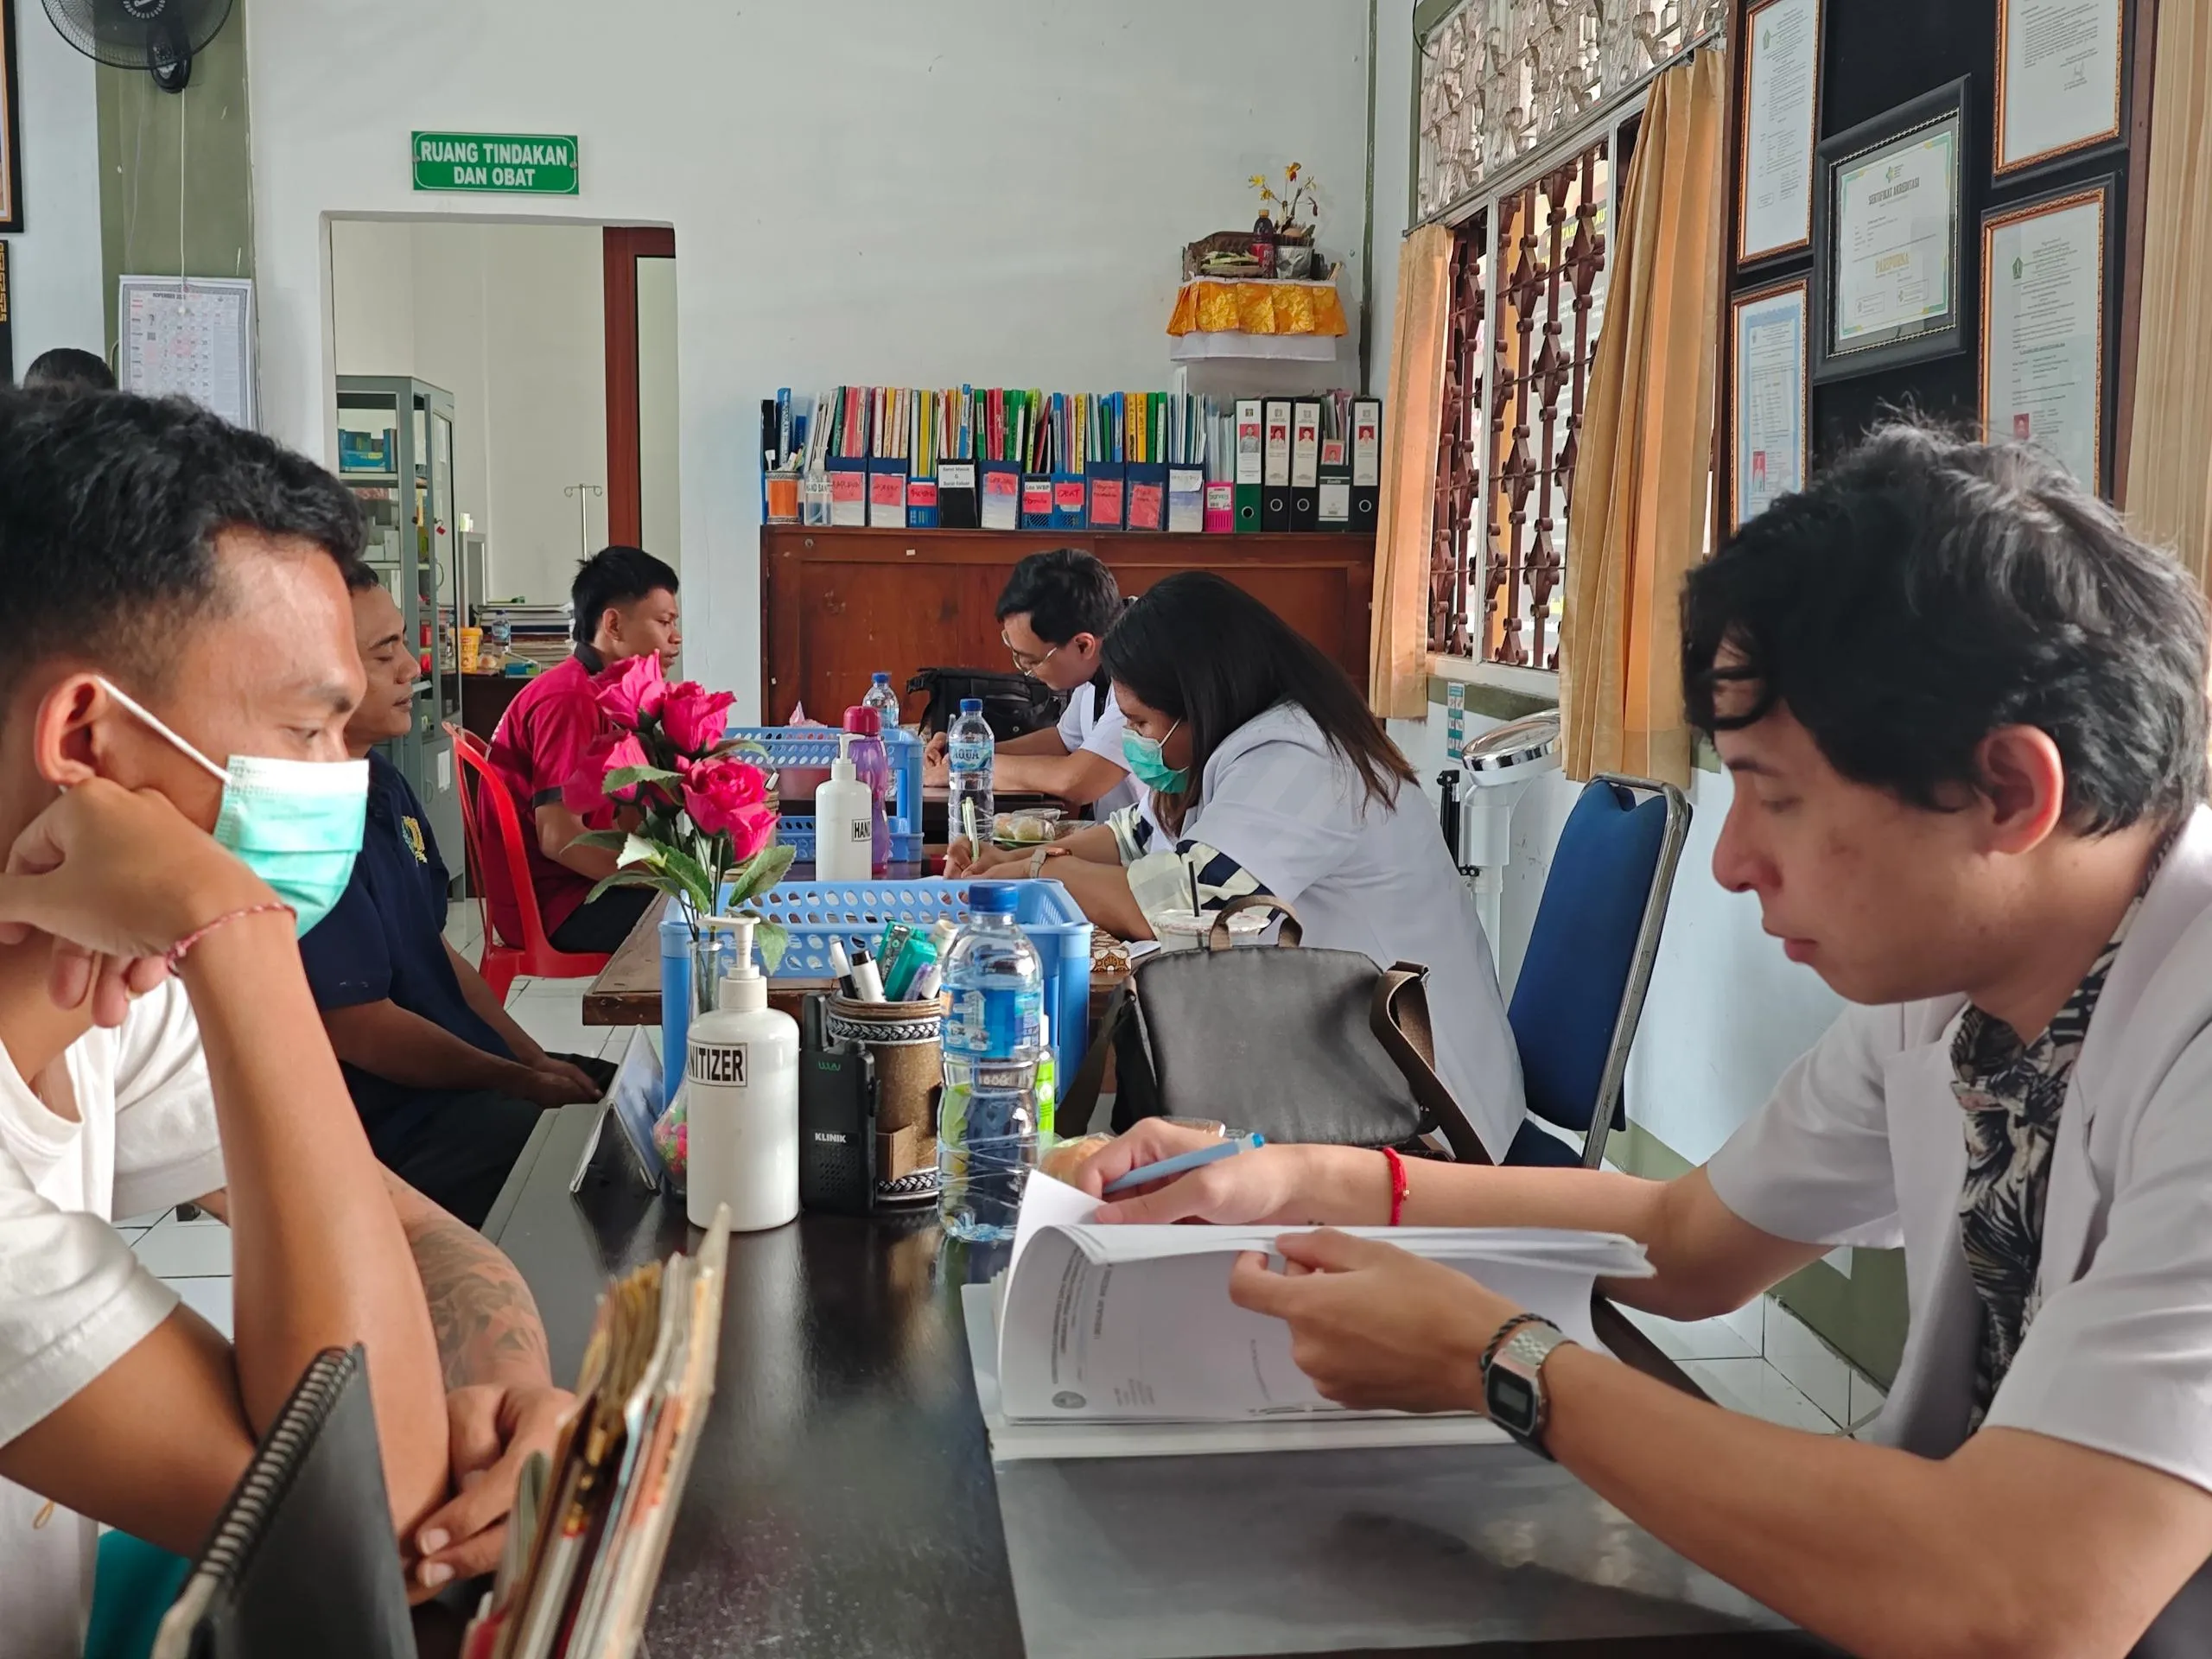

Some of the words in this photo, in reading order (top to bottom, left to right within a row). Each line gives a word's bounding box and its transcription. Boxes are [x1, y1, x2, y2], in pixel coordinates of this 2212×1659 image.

[420, 141, 478, 162] RUANG
[483, 143, 567, 166] TINDAKAN
[454, 167, 486, 185] DAN
[492, 168, 536, 187] OBAT
[953, 748, 979, 760] AQUA
[688, 1045, 744, 1082] NITIZER
[815, 1132, 847, 1143] KLINIK
